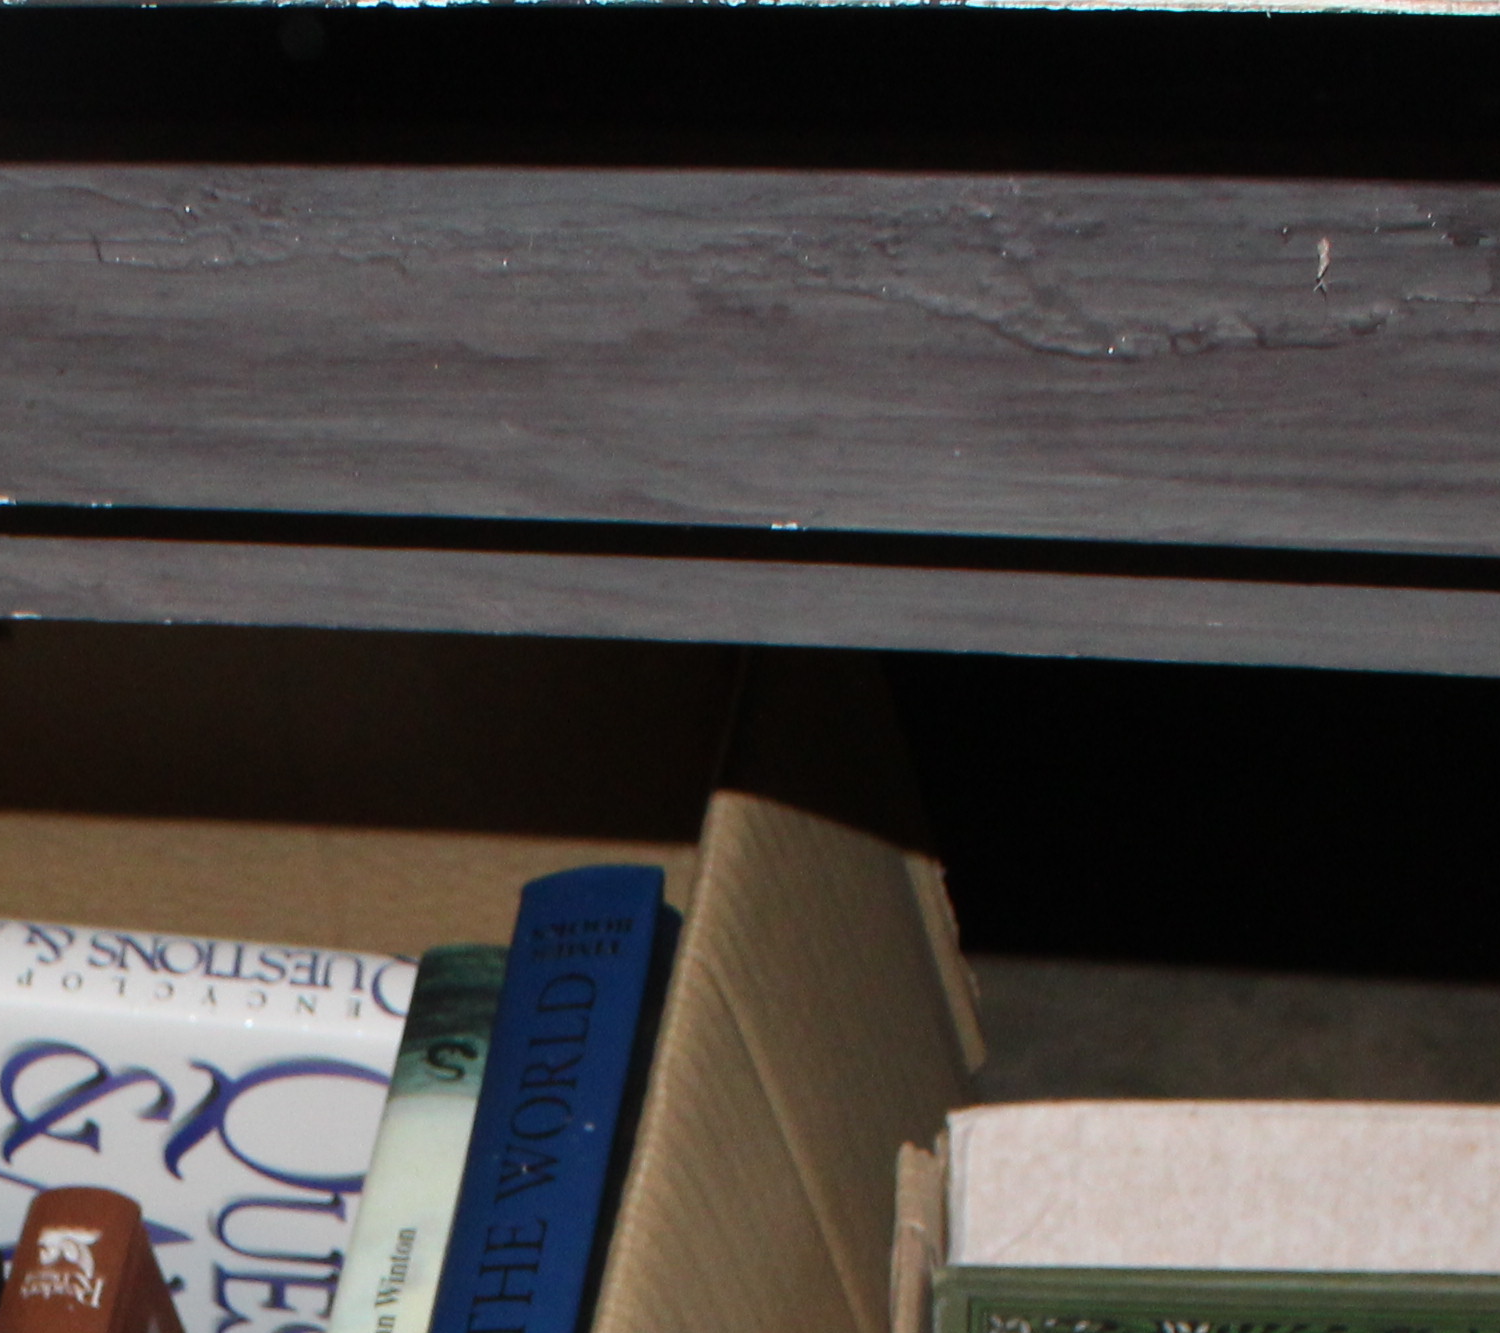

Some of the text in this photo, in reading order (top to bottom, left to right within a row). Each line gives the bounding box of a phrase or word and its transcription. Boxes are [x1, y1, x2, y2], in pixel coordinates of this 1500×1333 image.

[24, 923, 76, 966] &
[495, 971, 599, 1205] WORLD
[375, 1227, 417, 1309] Winton
